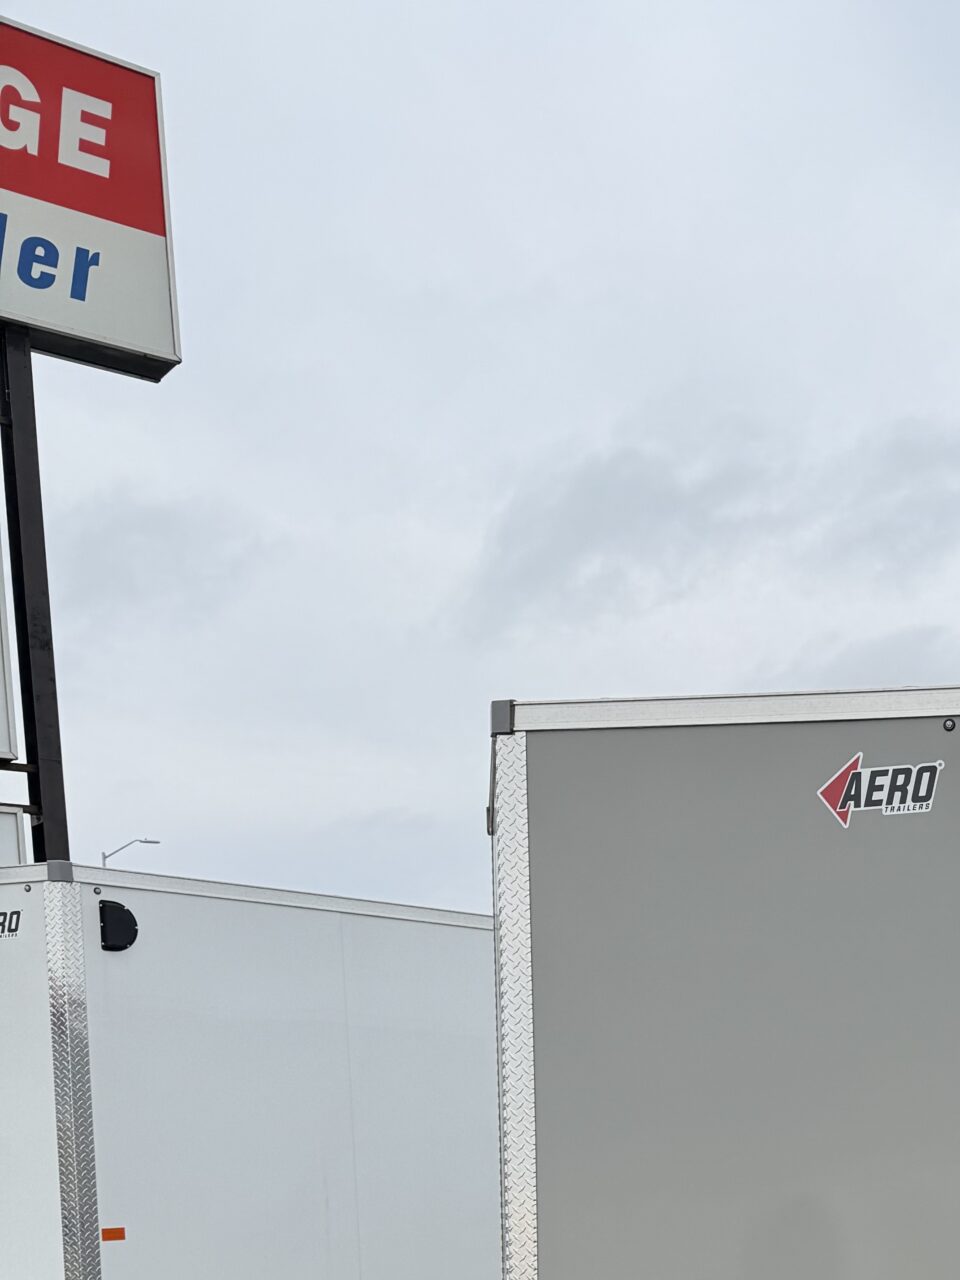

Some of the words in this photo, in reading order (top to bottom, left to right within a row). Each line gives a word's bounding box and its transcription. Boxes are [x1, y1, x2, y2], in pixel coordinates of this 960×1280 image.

[0, 64, 112, 178] GE
[839, 765, 938, 809] AERO
[885, 803, 930, 813] TRAILERS
